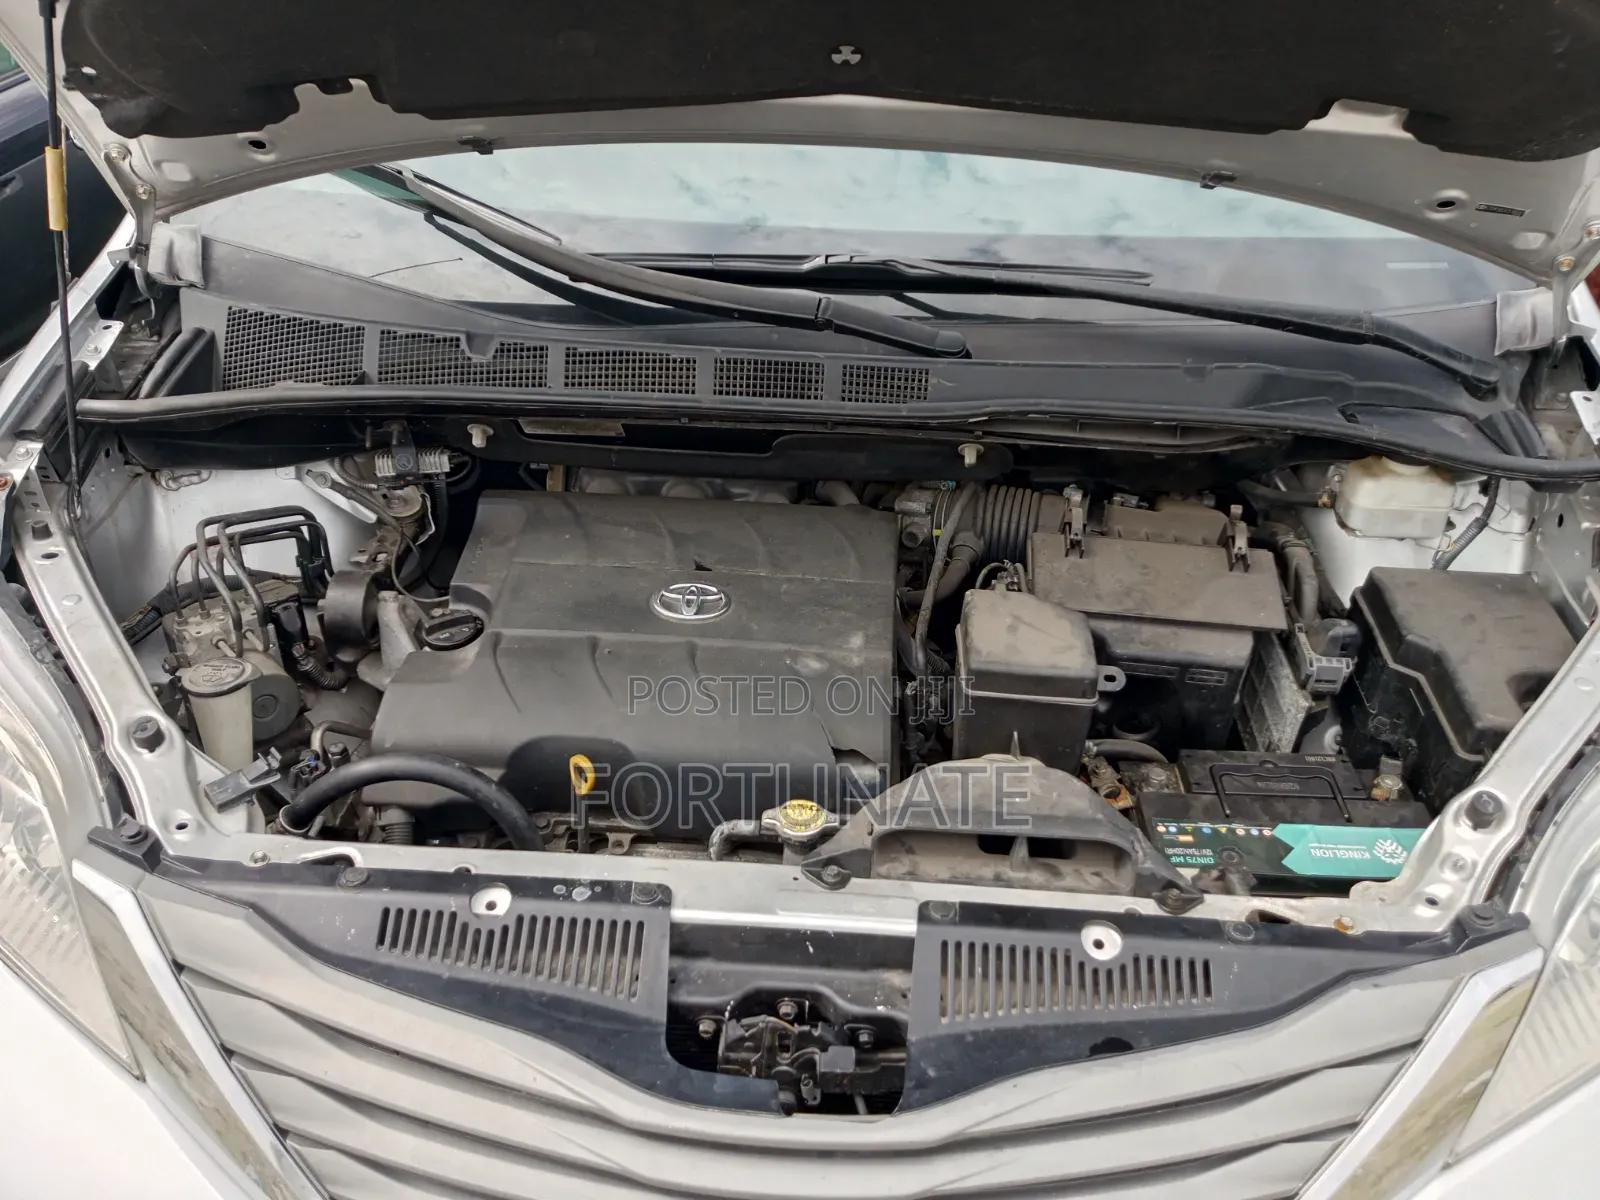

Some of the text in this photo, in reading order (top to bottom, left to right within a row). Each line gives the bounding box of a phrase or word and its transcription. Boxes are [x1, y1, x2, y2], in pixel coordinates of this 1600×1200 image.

[1310, 847, 1372, 859] KINGLION
[1170, 855, 1215, 864] DIN75 MF
